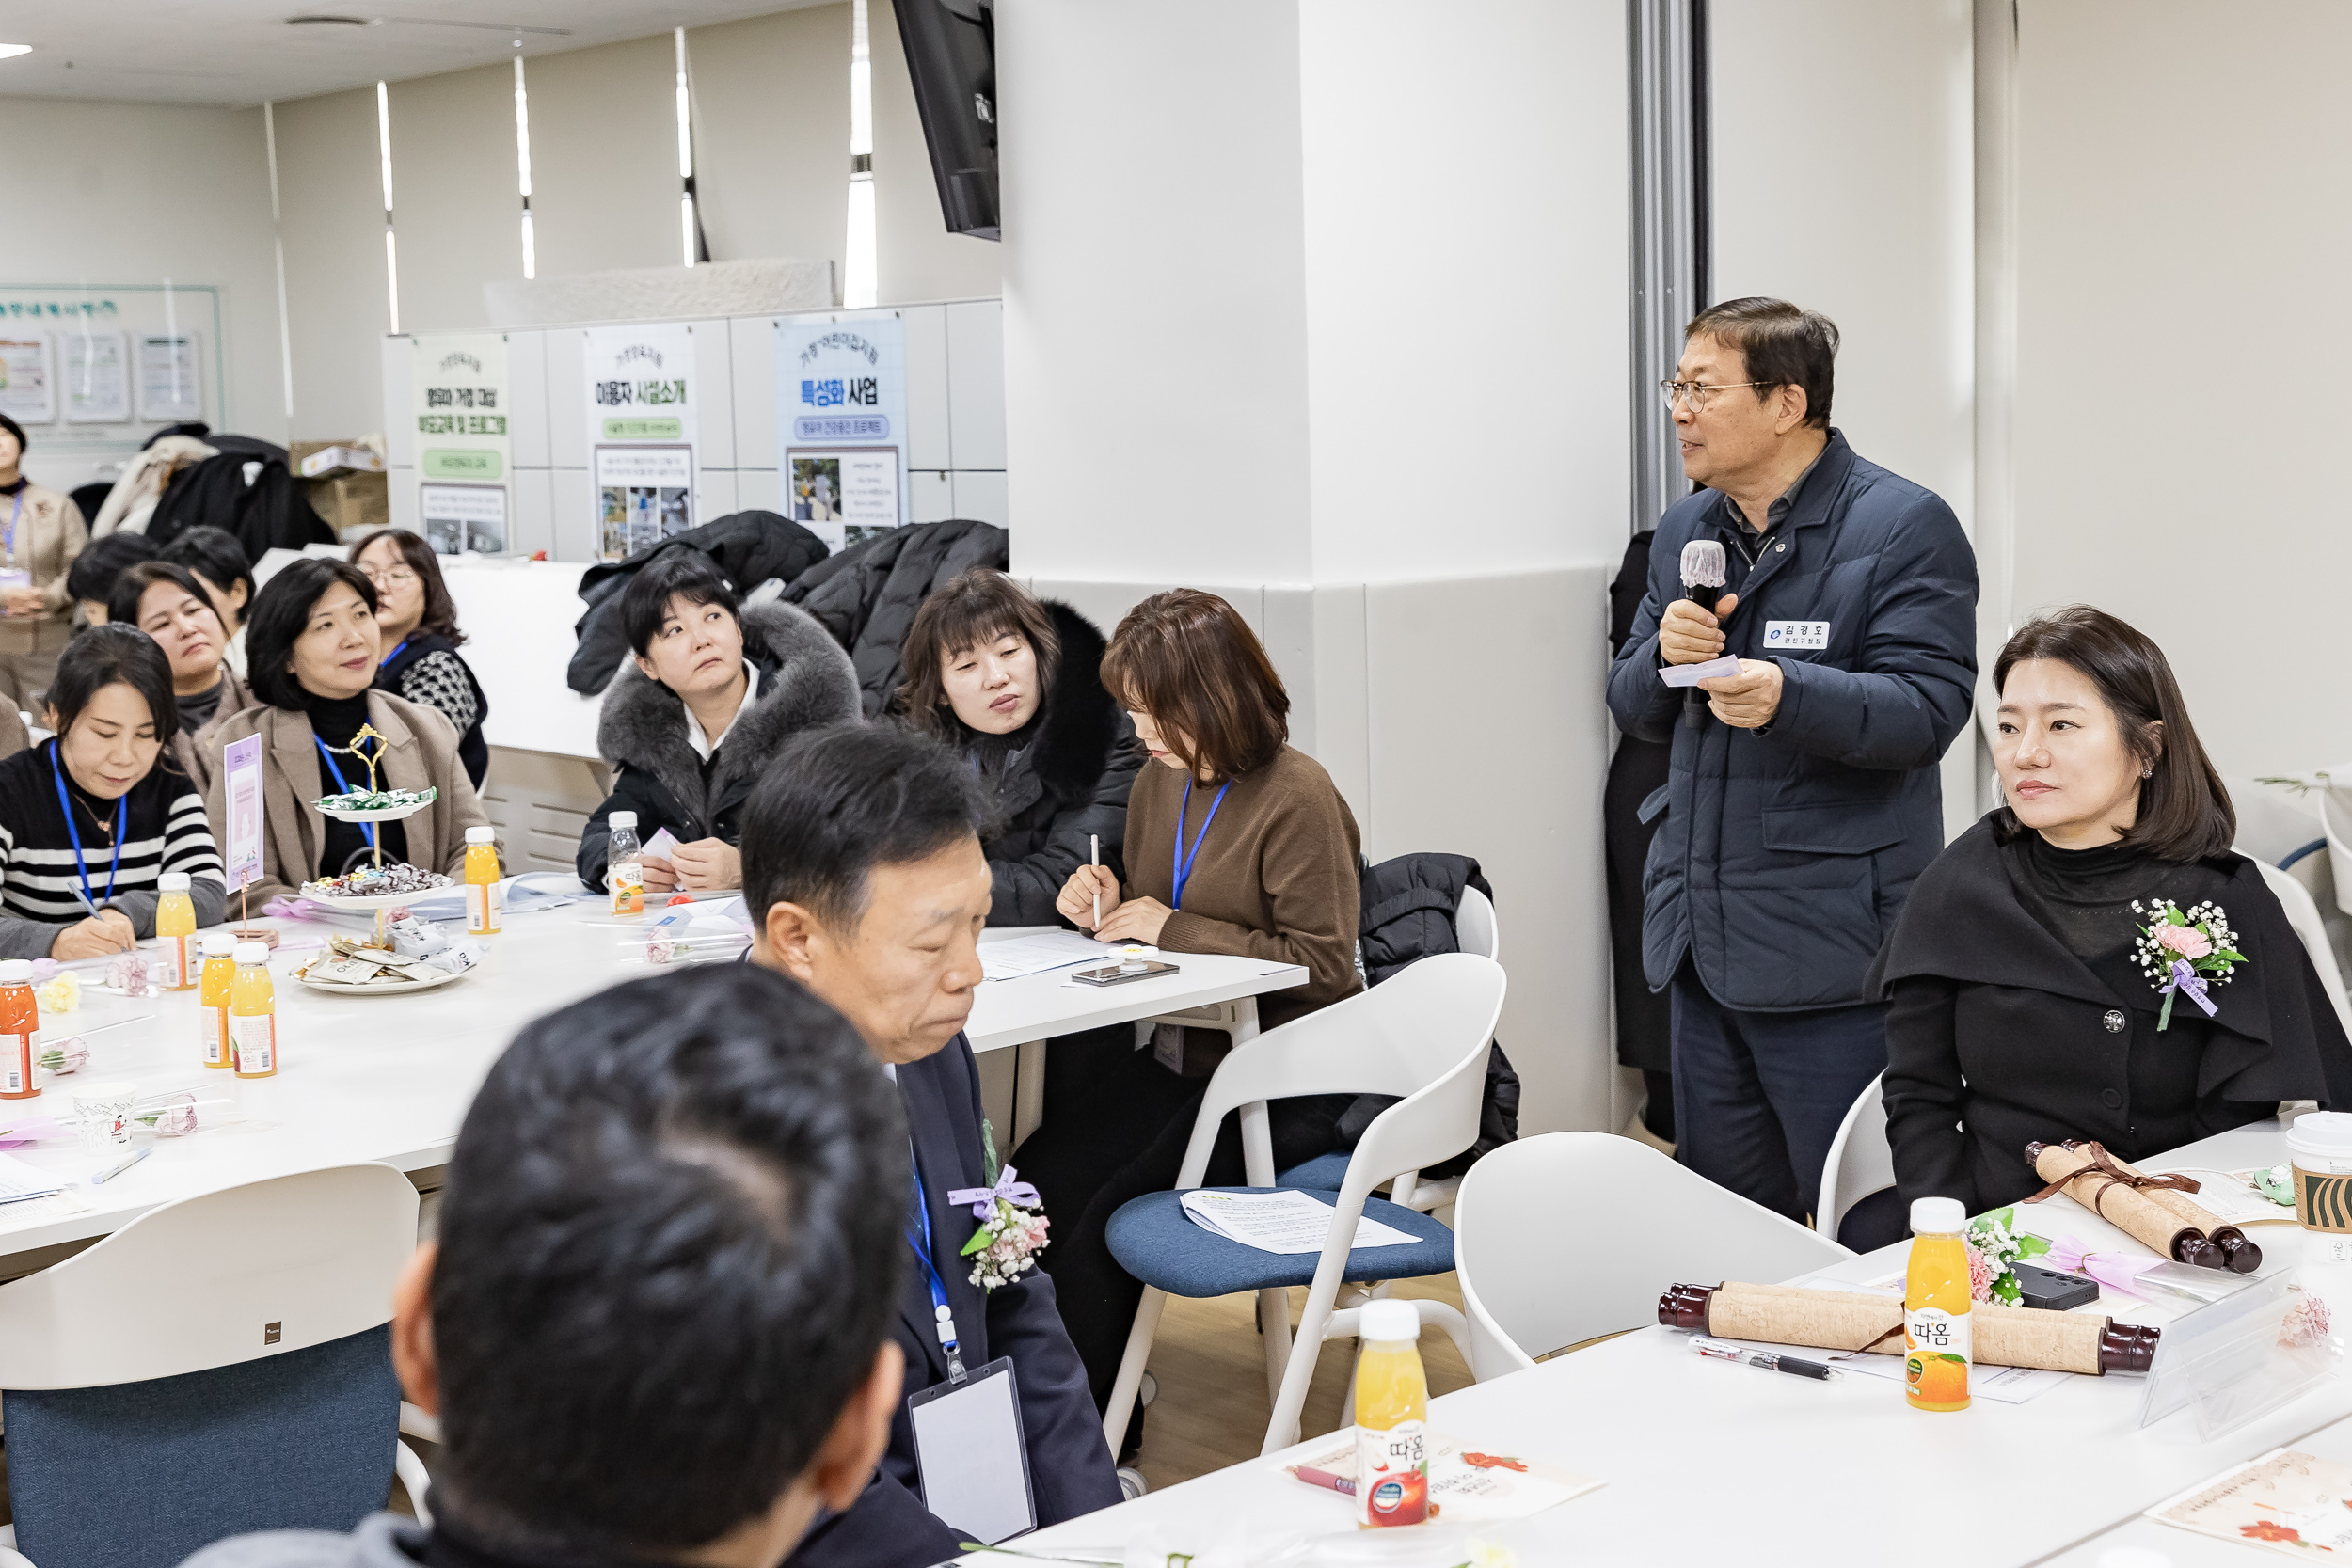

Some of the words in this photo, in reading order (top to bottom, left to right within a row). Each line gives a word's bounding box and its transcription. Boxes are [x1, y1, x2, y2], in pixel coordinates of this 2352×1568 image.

[636, 379, 687, 405] 시설소개
[801, 379, 845, 407] 특성화
[848, 377, 879, 405] 사업
